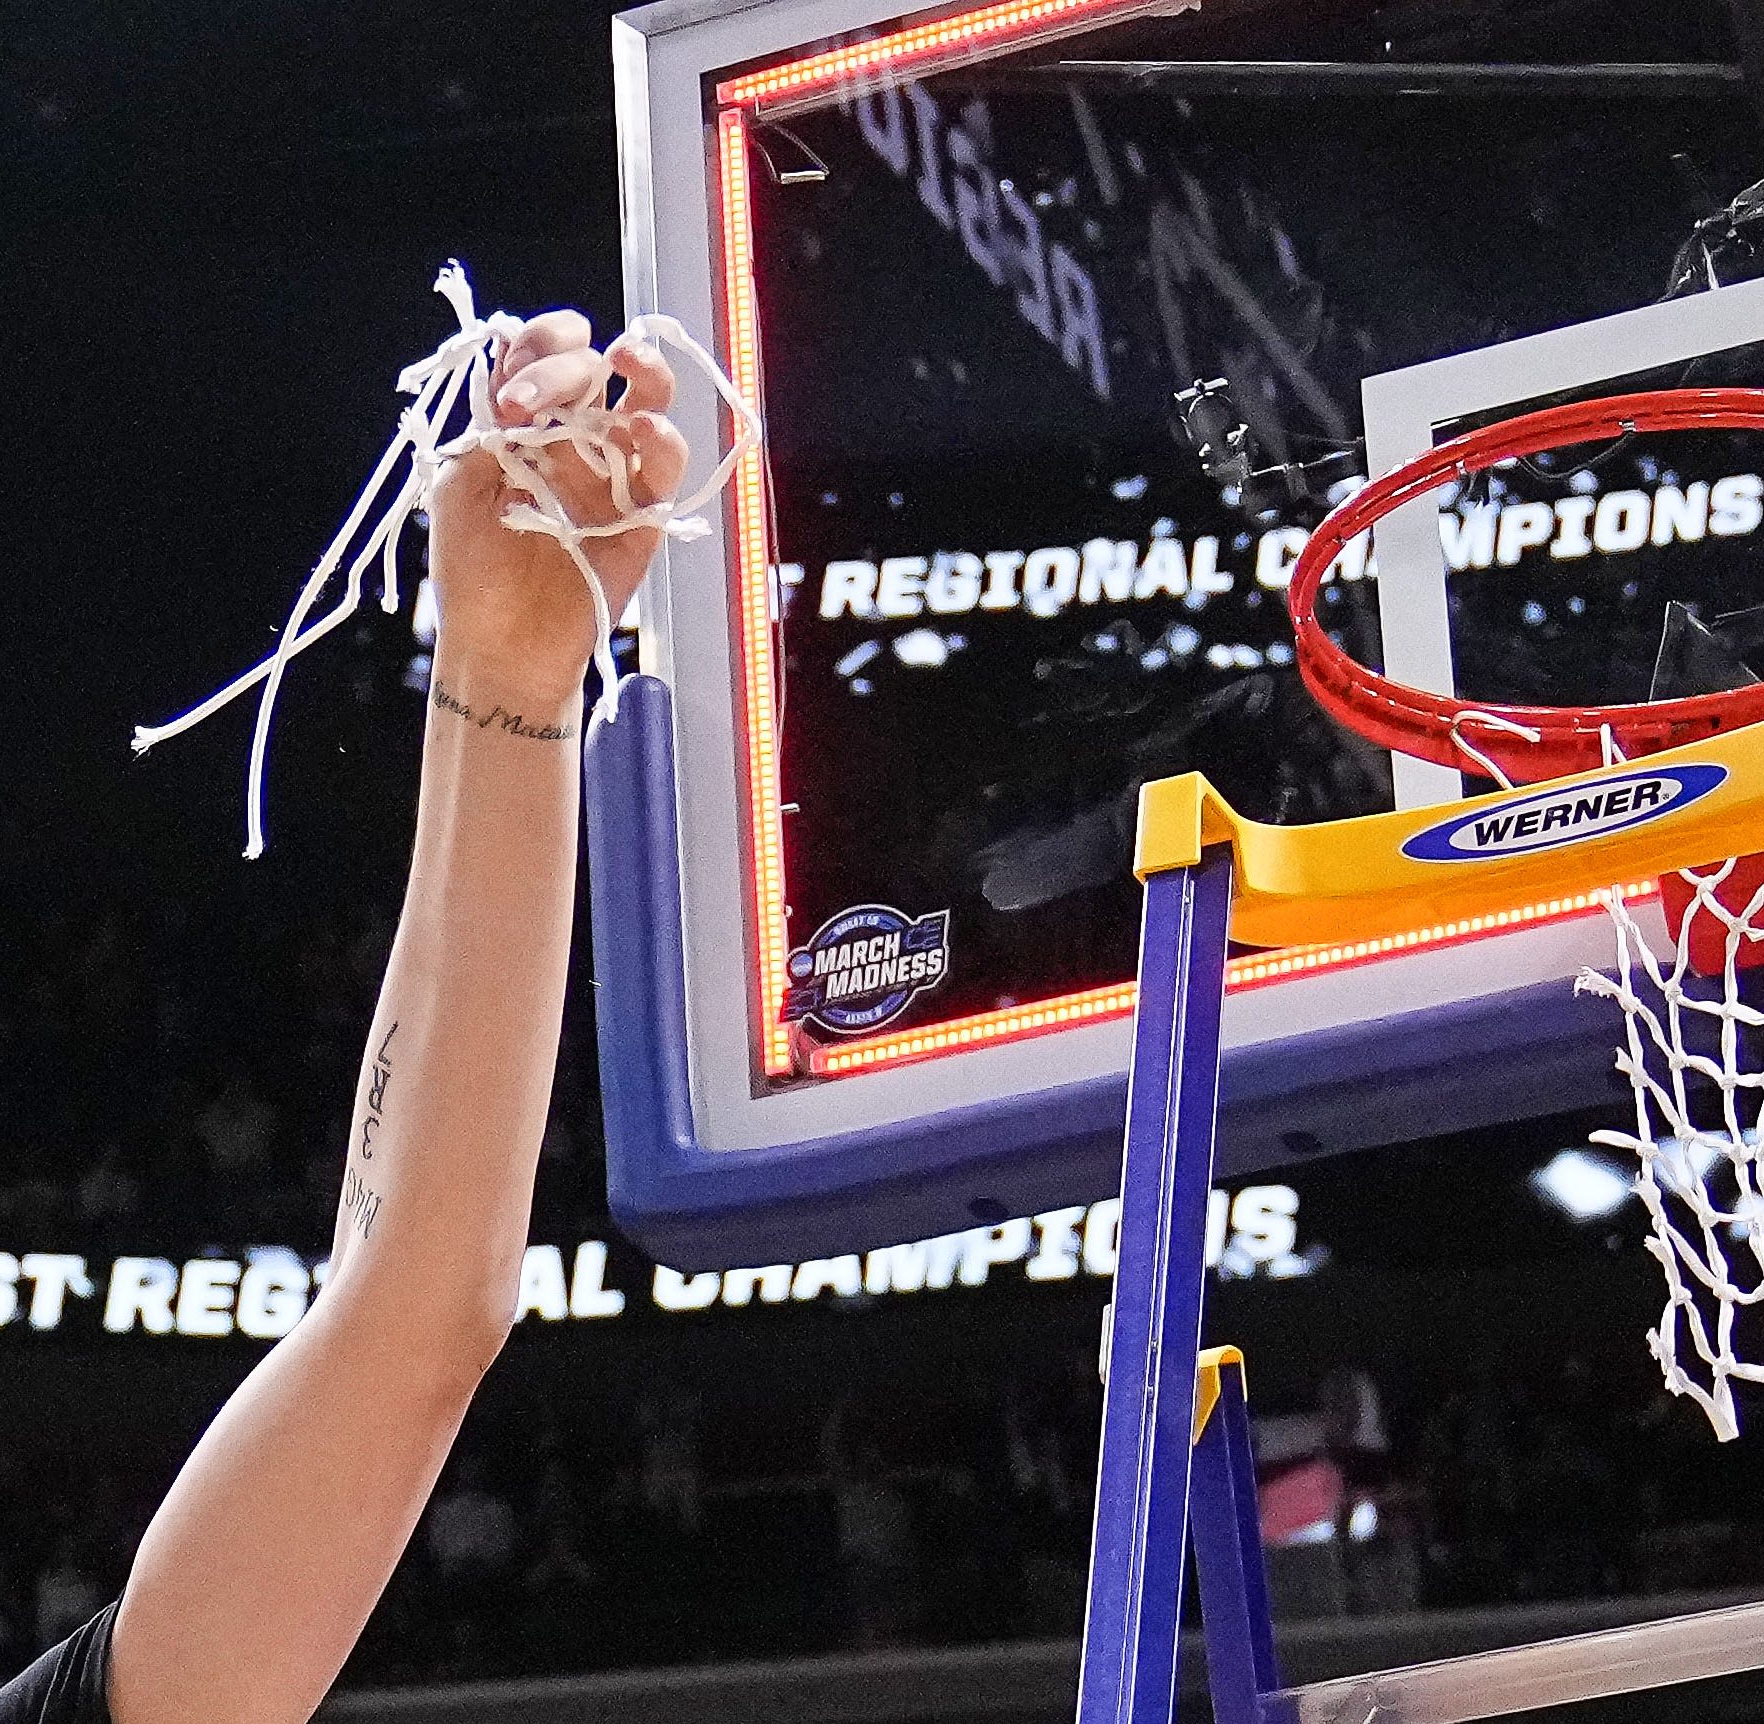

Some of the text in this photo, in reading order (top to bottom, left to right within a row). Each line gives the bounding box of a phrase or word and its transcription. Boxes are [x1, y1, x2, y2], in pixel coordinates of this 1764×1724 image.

[818, 533, 1233, 620] REGIONAL
[1474, 780, 1662, 847] WERNER
[815, 931, 901, 977] MARCH
[826, 948, 944, 1000] MADNESS
